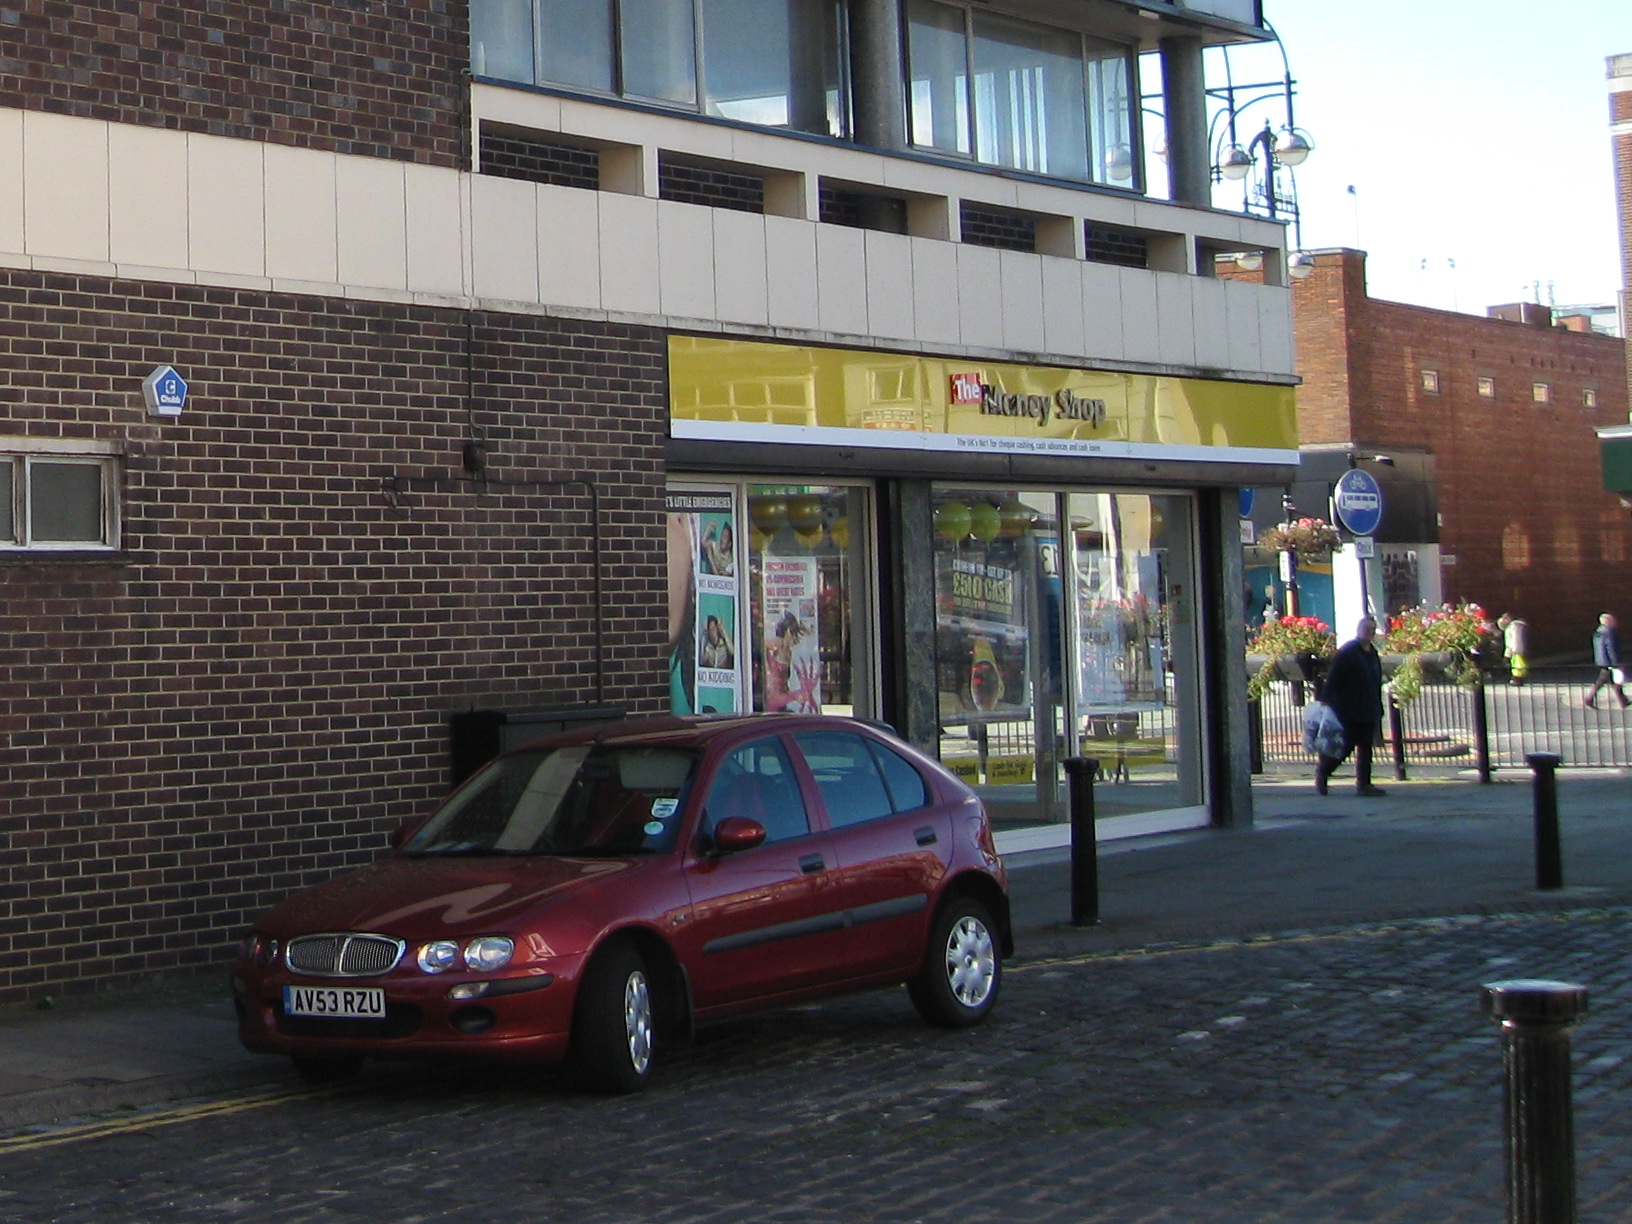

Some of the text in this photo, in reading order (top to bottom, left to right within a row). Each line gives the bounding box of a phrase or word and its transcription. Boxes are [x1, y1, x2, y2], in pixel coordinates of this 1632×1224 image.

[955, 378, 980, 401] The
[981, 383, 1107, 429] Money Shop
[295, 989, 382, 1014] AV53 RZU
